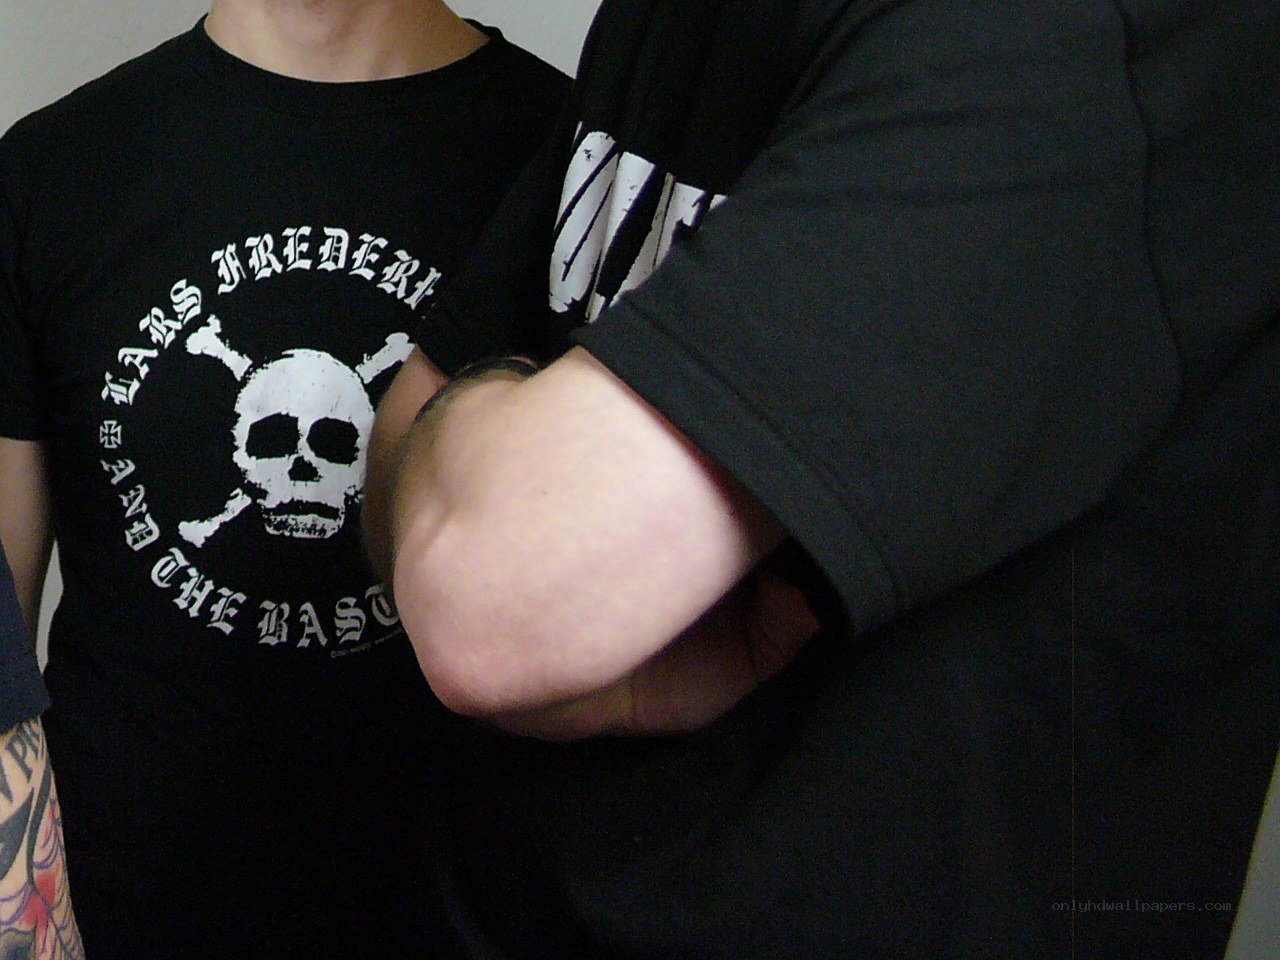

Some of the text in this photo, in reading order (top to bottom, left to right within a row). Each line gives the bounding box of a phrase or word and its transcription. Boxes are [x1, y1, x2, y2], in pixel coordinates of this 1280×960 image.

[101, 278, 202, 406] LARS
[100, 459, 160, 552] AND
[150, 547, 247, 636] THE
